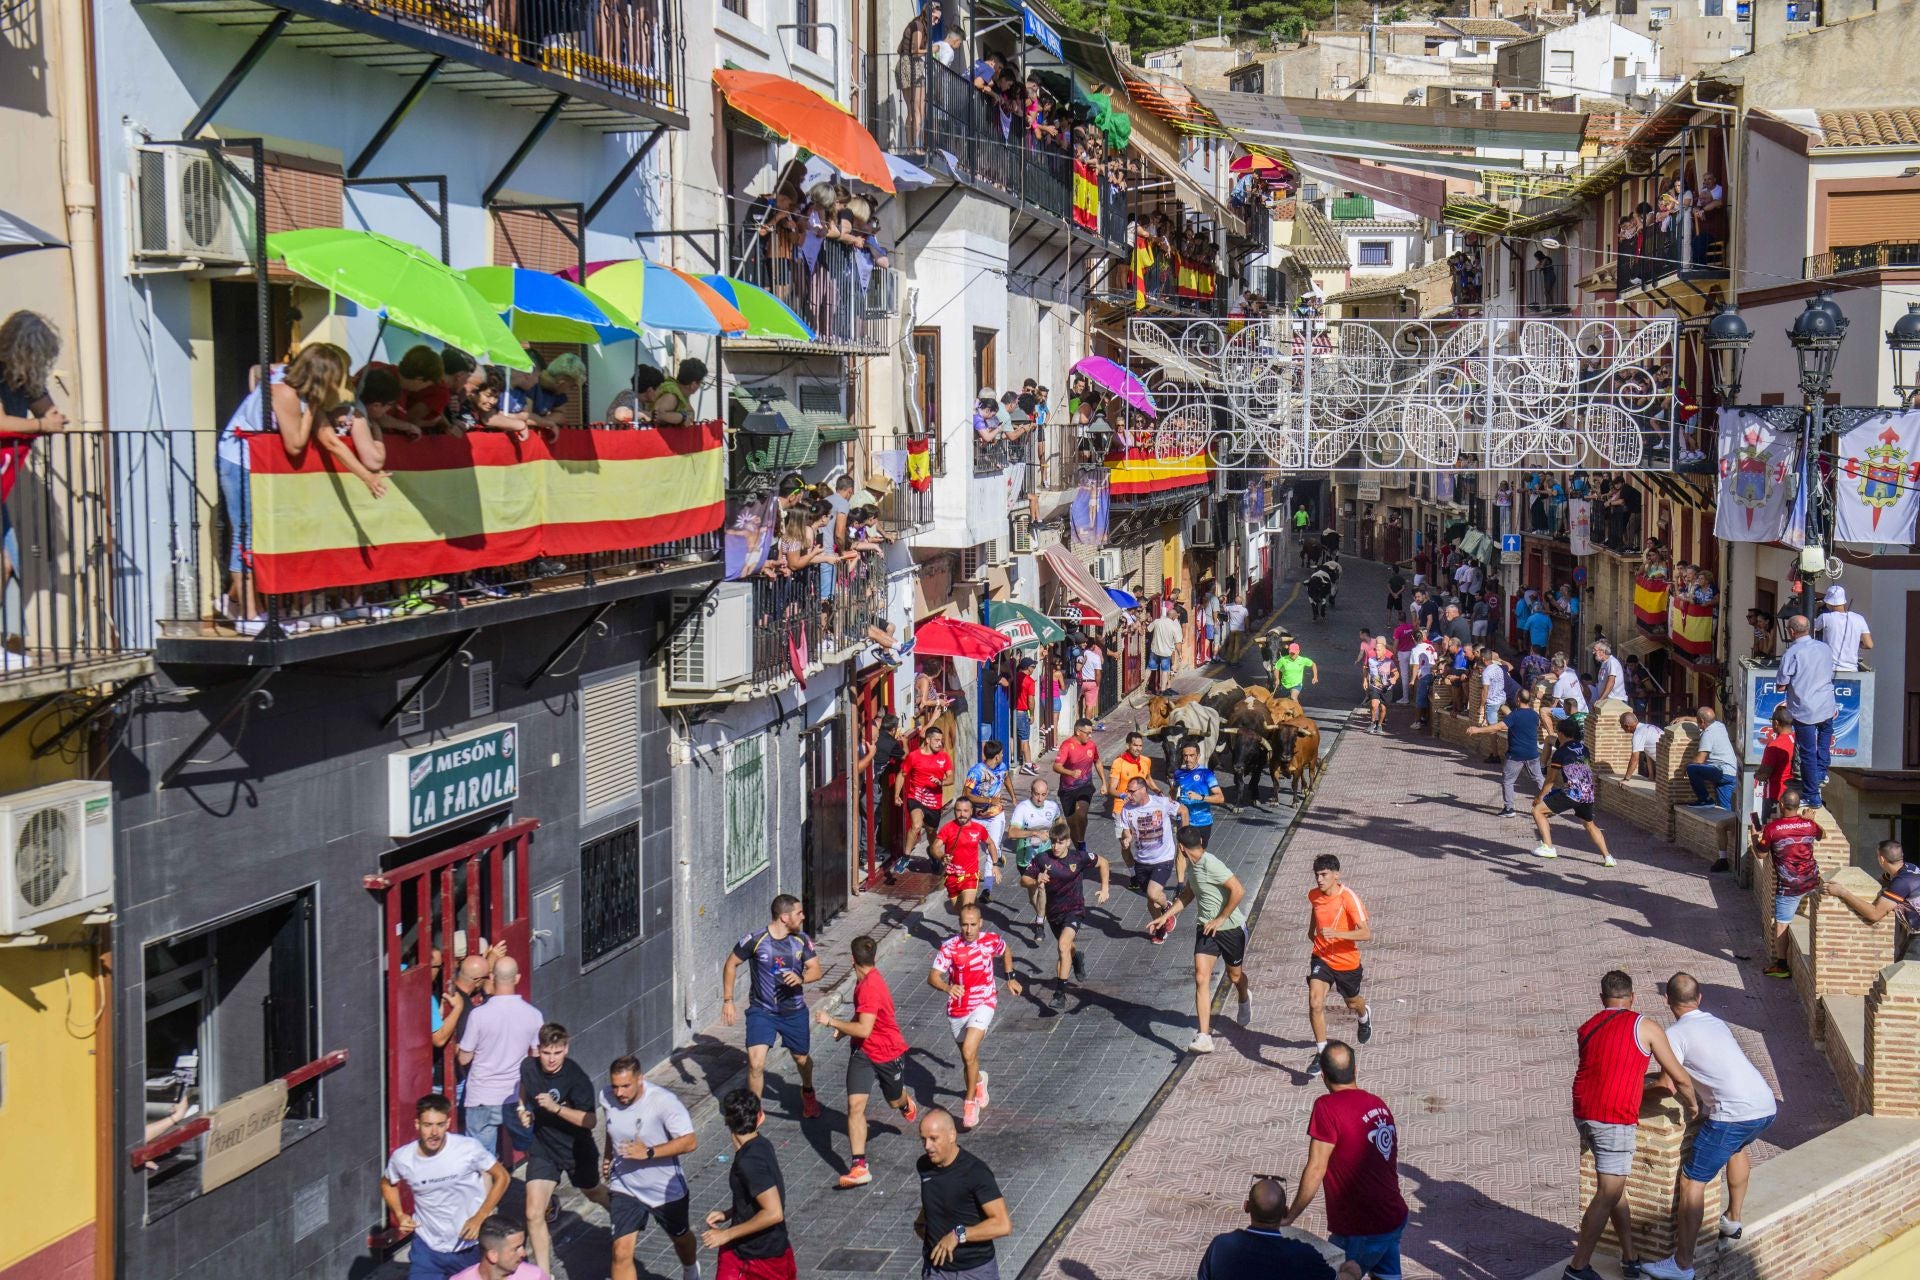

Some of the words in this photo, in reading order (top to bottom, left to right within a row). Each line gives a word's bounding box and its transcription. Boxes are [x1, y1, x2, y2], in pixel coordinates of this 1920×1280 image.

[436, 739, 496, 773] MESÓN
[412, 790, 436, 826] LA
[442, 764, 515, 816] FAROLA
